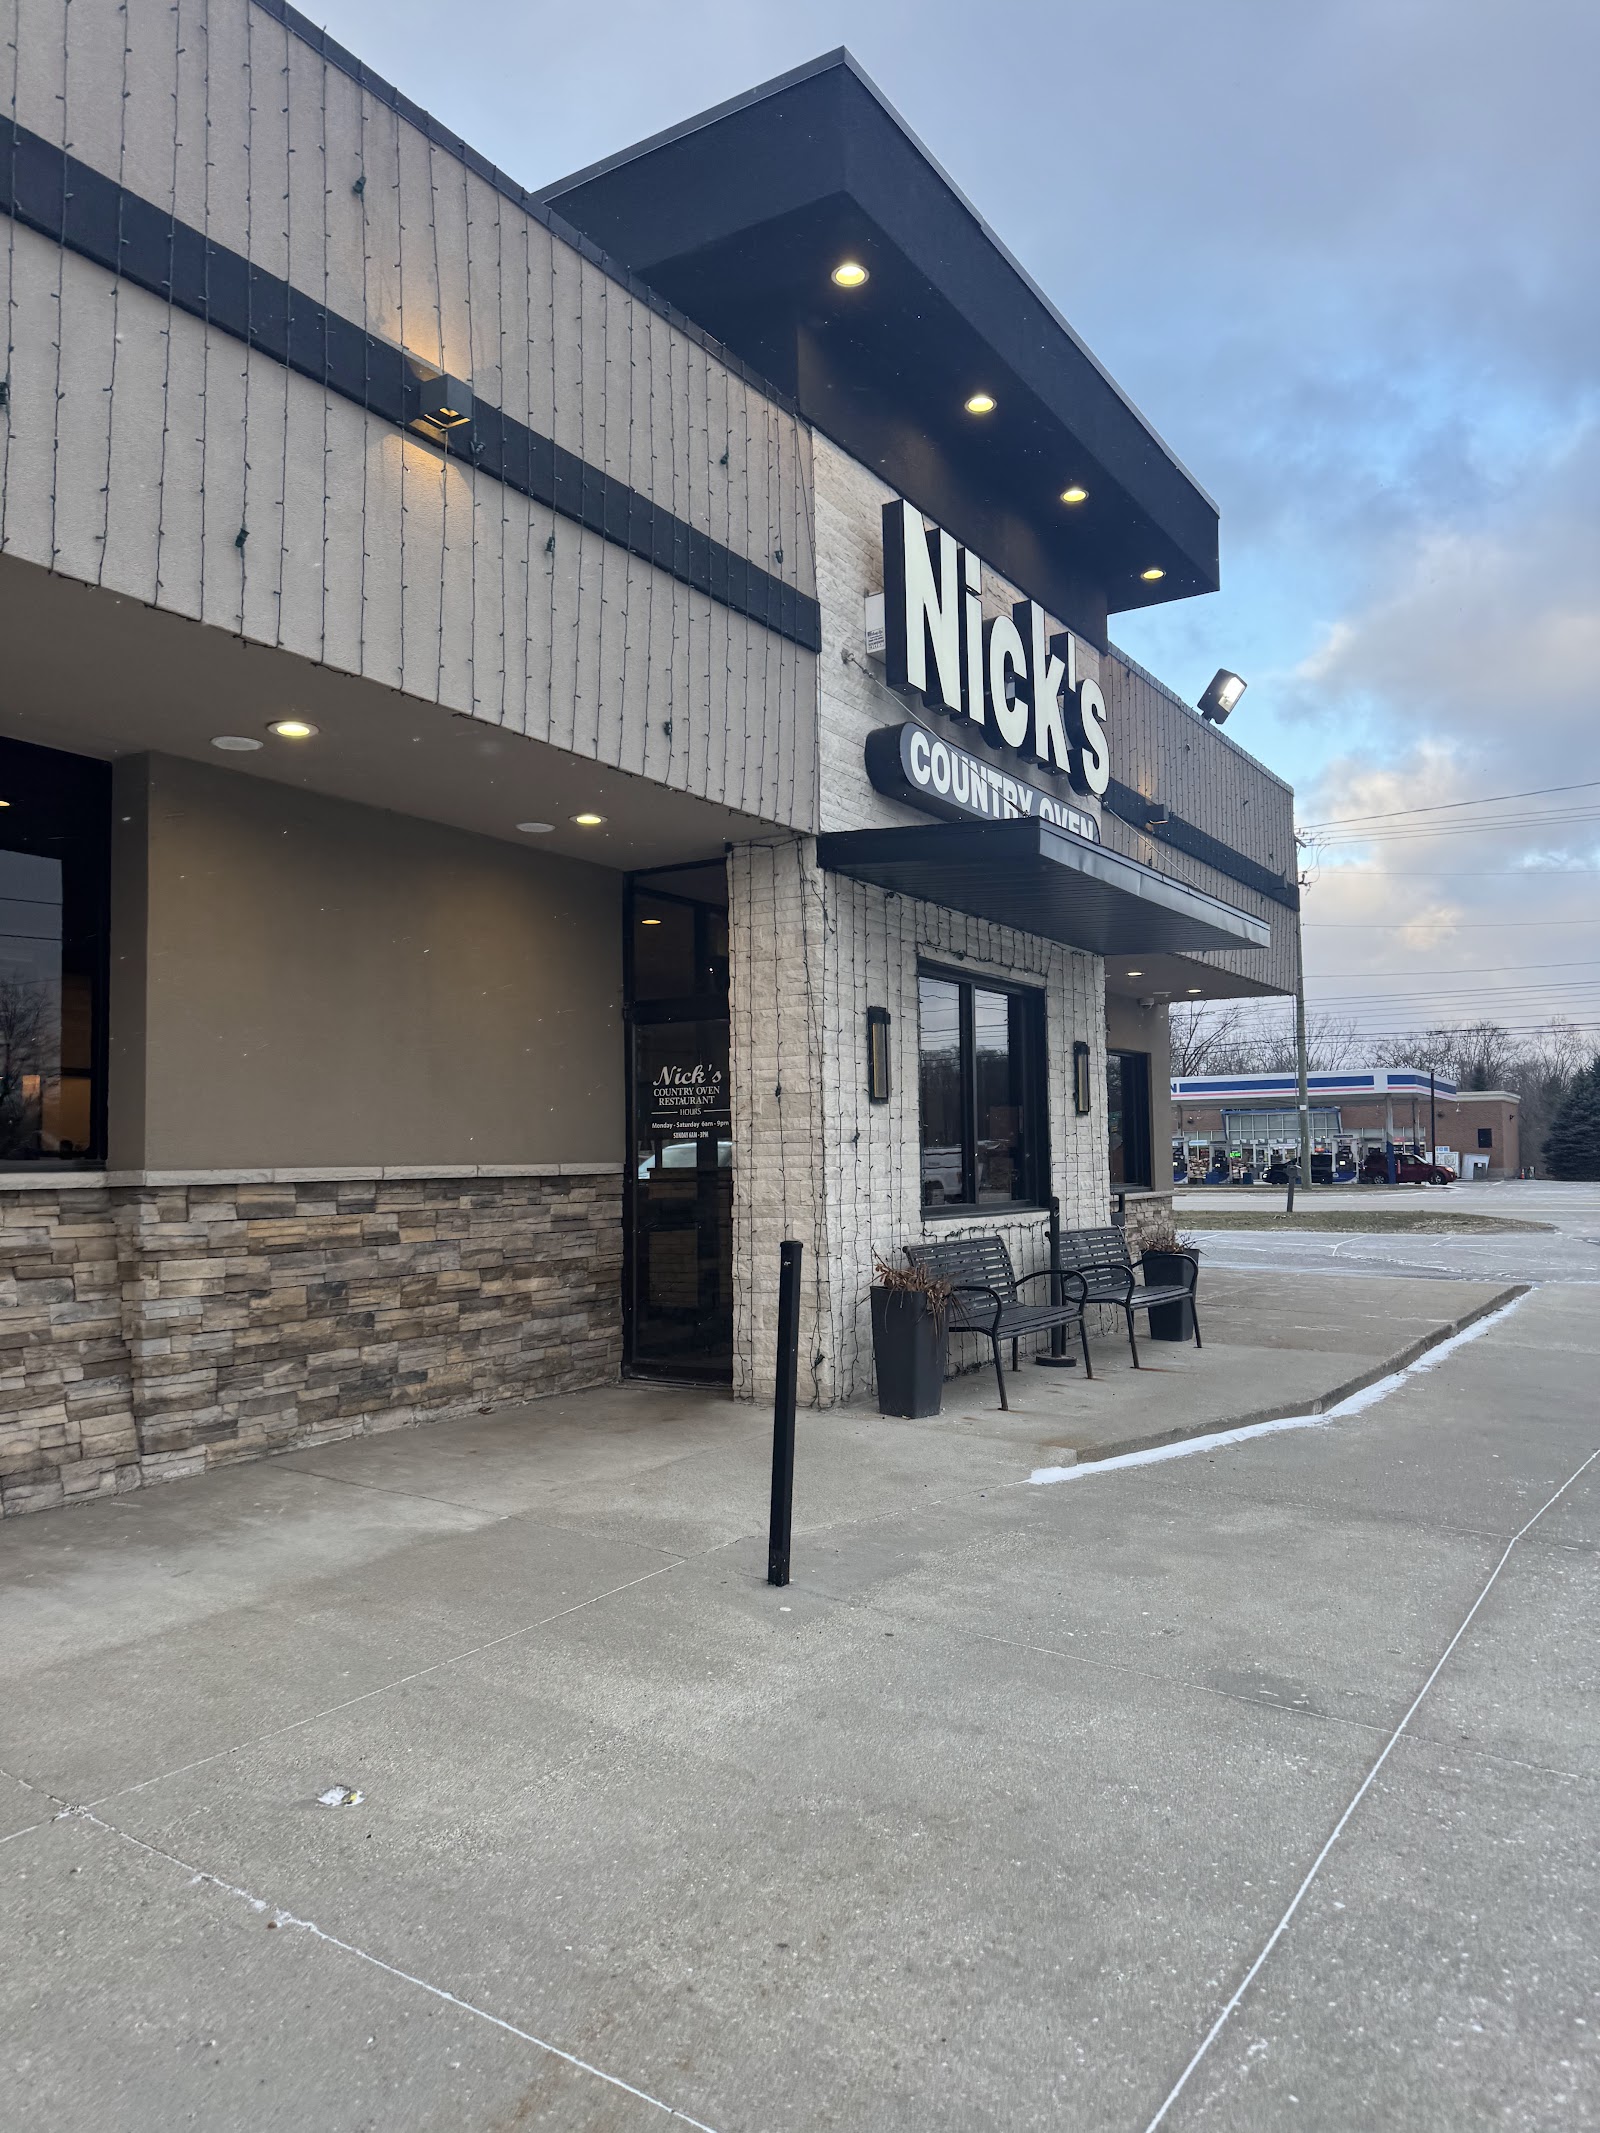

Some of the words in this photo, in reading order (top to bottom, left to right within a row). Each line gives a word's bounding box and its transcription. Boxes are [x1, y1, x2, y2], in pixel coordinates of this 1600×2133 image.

[903, 499, 1110, 794] Nick's
[910, 731, 1034, 820] COUNTRY
[653, 1064, 722, 1086] Nick's
[653, 1087, 694, 1097] COUNTRY
[696, 1086, 720, 1095] OVEN
[659, 1095, 715, 1106] RESTAURANT
[680, 1108, 702, 1116] HOURS
[652, 1122, 673, 1130] Monday
[676, 1121, 700, 1129] Saturday
[717, 1120, 730, 1128] 9pm
